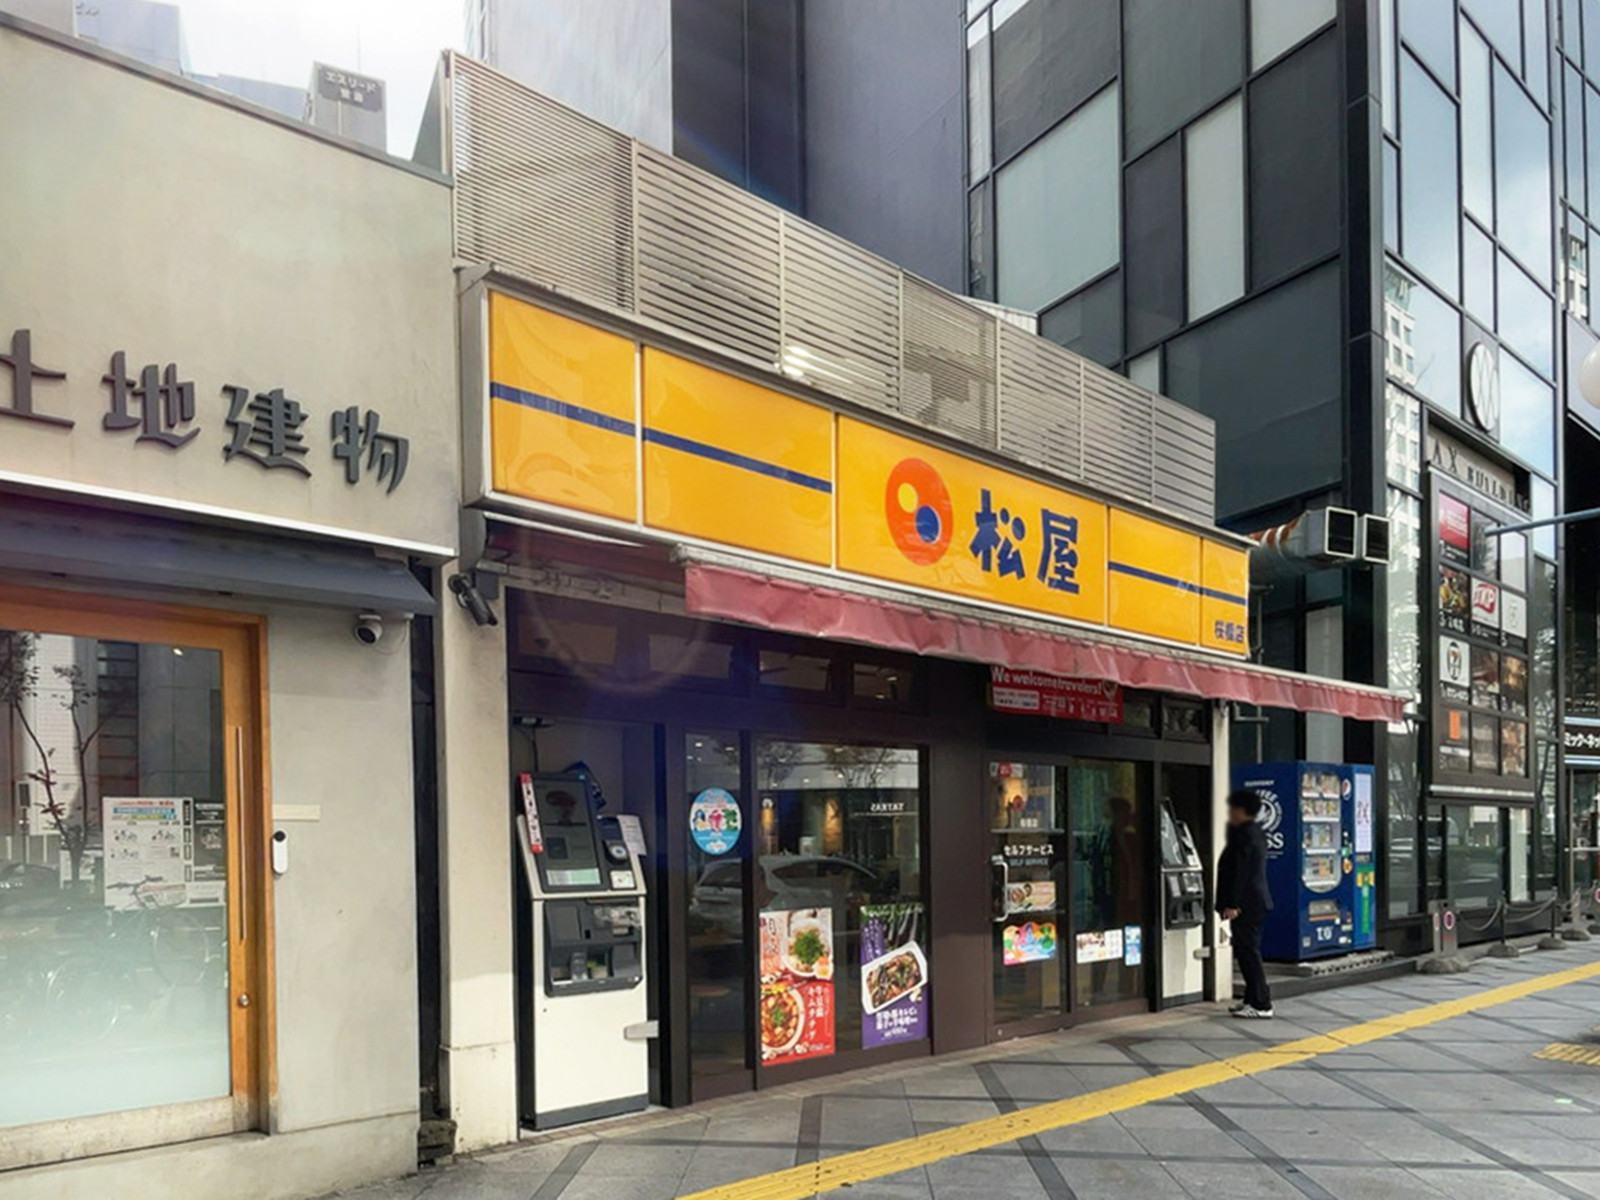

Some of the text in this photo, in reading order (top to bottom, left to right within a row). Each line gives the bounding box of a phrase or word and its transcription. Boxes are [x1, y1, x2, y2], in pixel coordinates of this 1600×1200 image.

[325, 71, 377, 94] エスリード
[0, 328, 409, 495] 土地建物
[1433, 440, 1530, 512] AX BUILDING
[969, 488, 1080, 594] 松屋
[1003, 844, 1054, 856] セルフサービス
